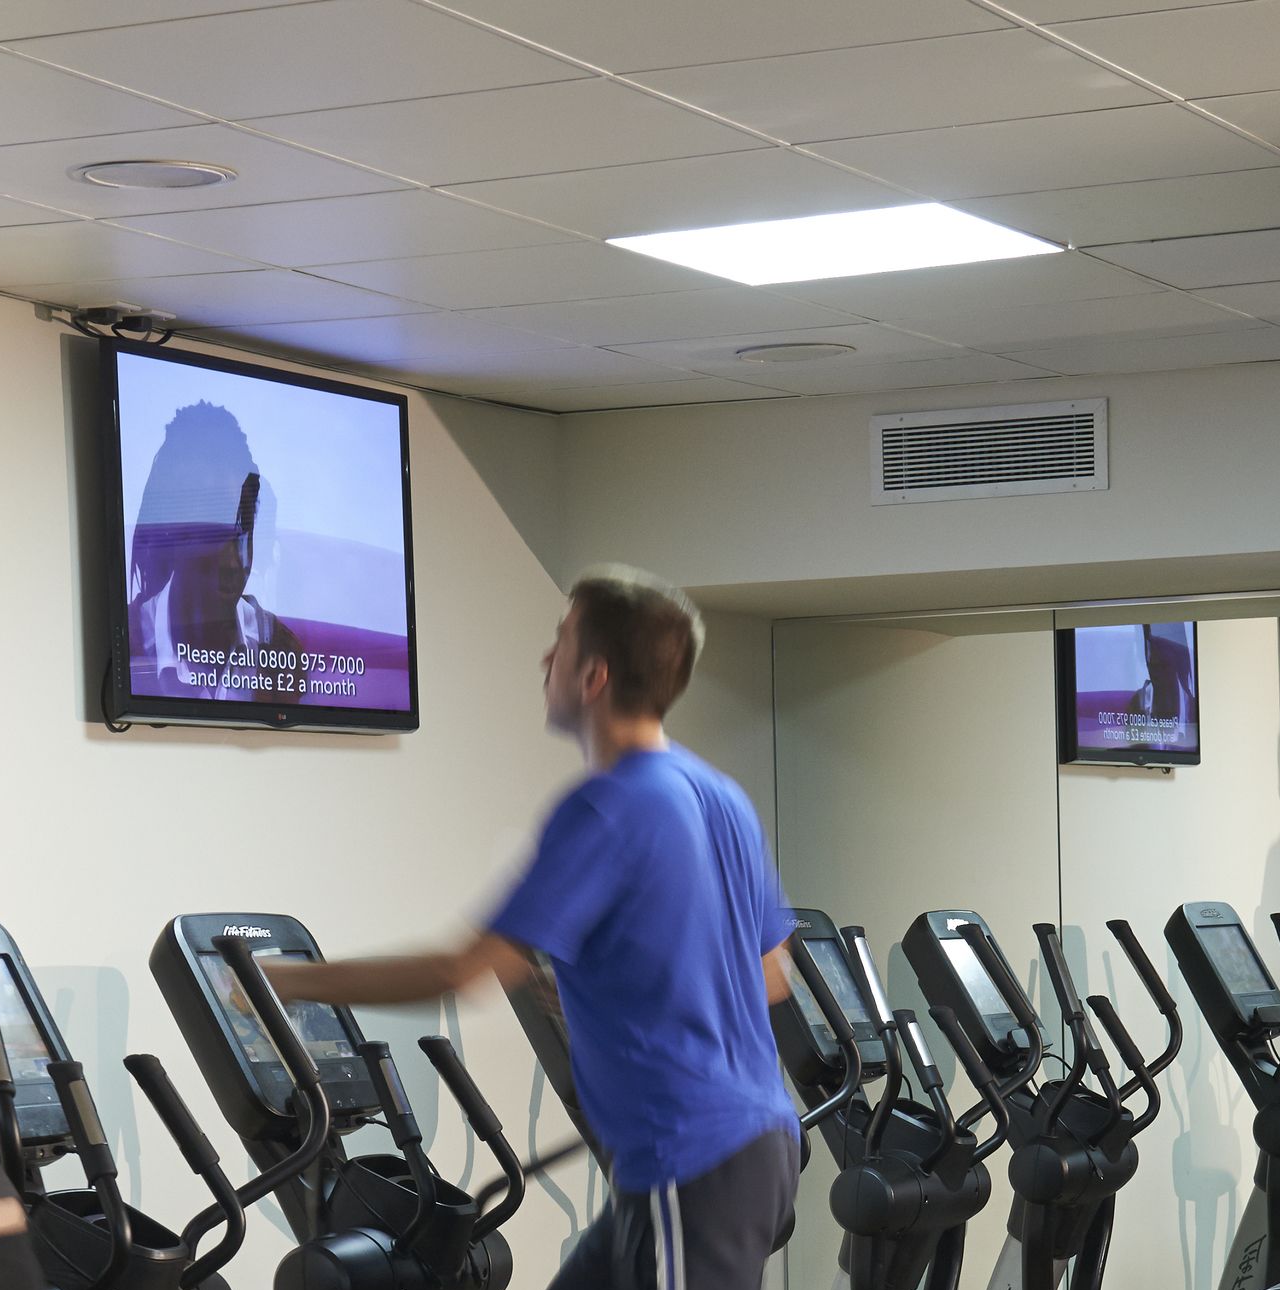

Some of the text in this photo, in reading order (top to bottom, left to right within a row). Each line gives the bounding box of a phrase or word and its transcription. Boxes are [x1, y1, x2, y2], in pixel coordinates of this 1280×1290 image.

[177, 643, 365, 676] Please call 0800 975 7000
[189, 669, 357, 696] and donate £2 a month
